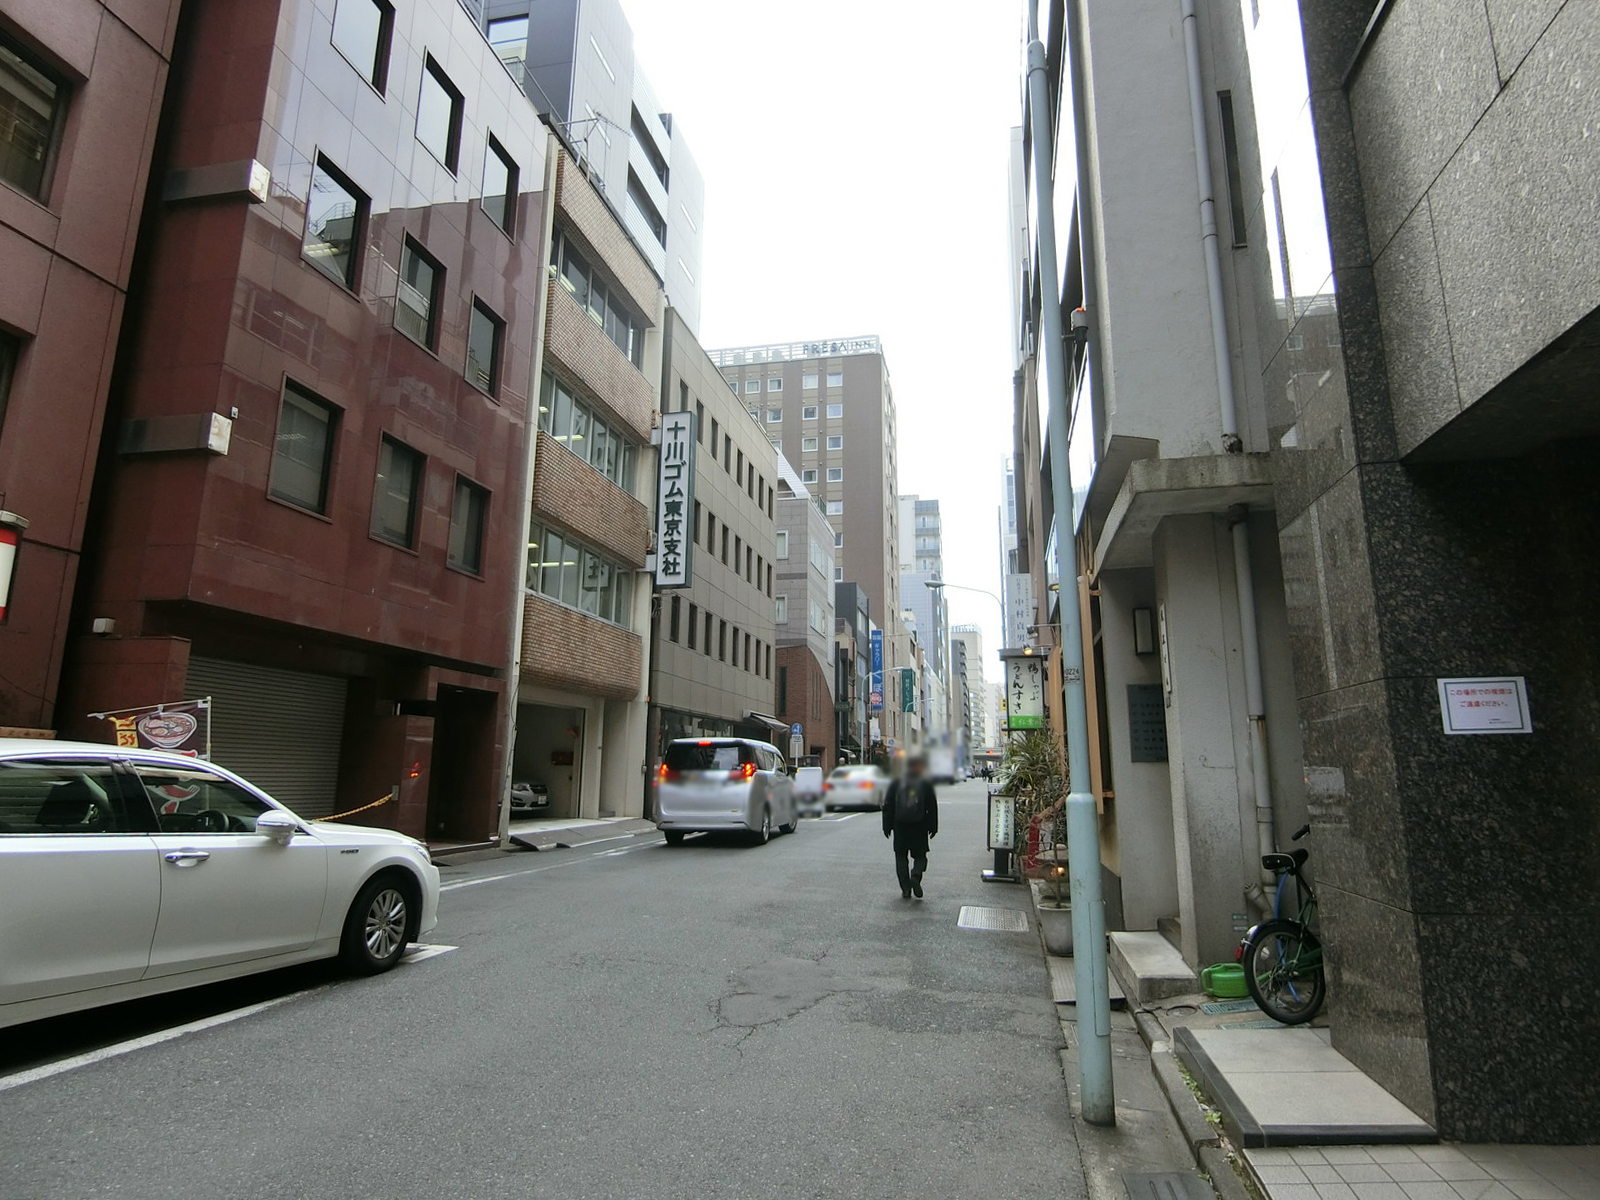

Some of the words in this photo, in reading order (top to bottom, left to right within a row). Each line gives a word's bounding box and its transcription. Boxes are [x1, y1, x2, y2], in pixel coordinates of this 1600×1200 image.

[851, 341, 871, 350] INN
[661, 420, 686, 577] 十川ゴム東京支社
[1011, 662, 1024, 714] うどんすき
